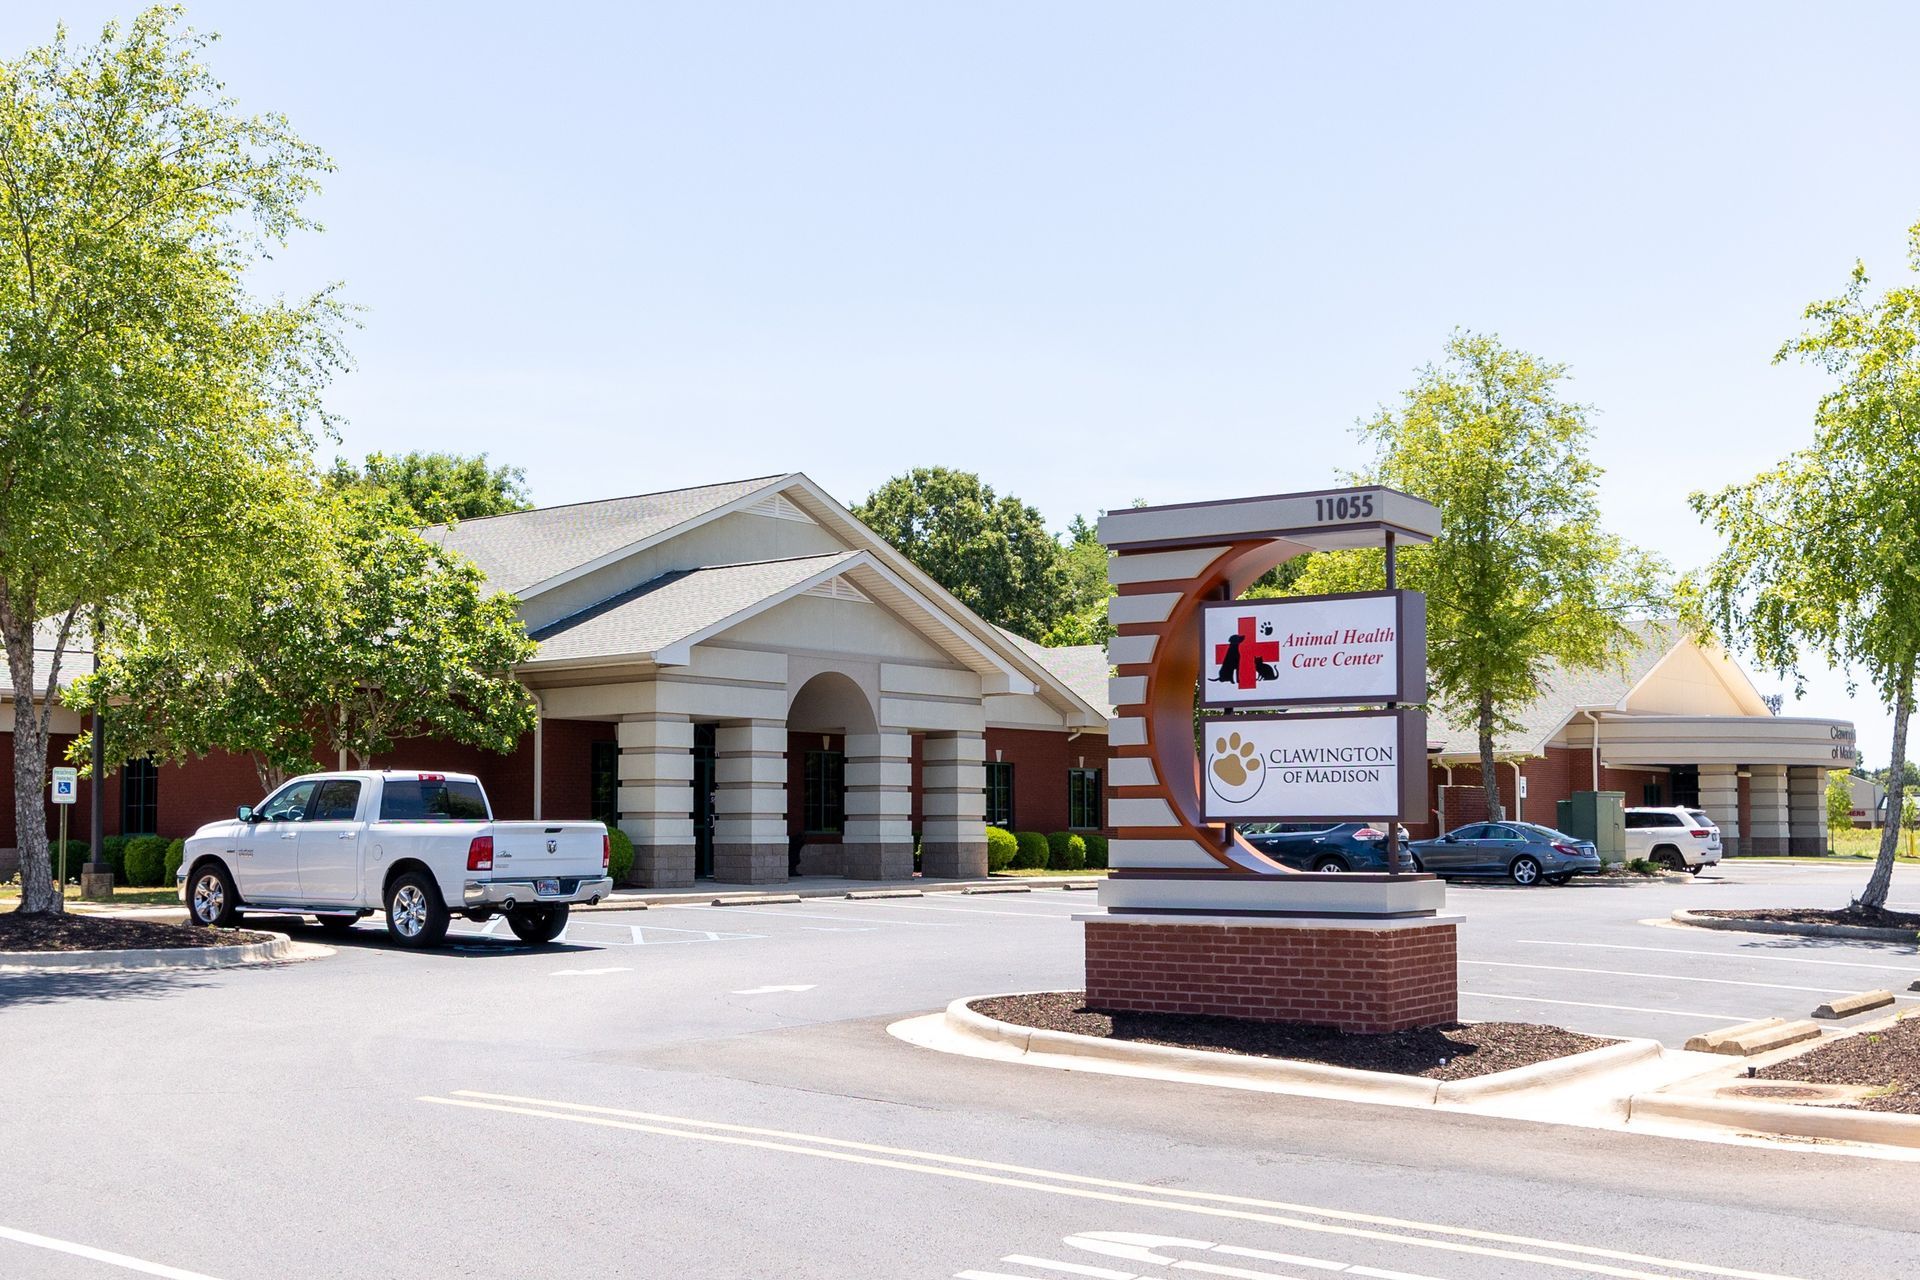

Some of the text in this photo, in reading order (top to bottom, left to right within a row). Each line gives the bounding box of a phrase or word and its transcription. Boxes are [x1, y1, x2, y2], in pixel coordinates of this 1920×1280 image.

[1316, 495, 1373, 521] 11055
[1283, 627, 1395, 648] Animal Health
[1292, 651, 1384, 668] Care Center
[1270, 746, 1393, 764] CLAWINGTON
[1282, 769, 1379, 783] OF MADISON
